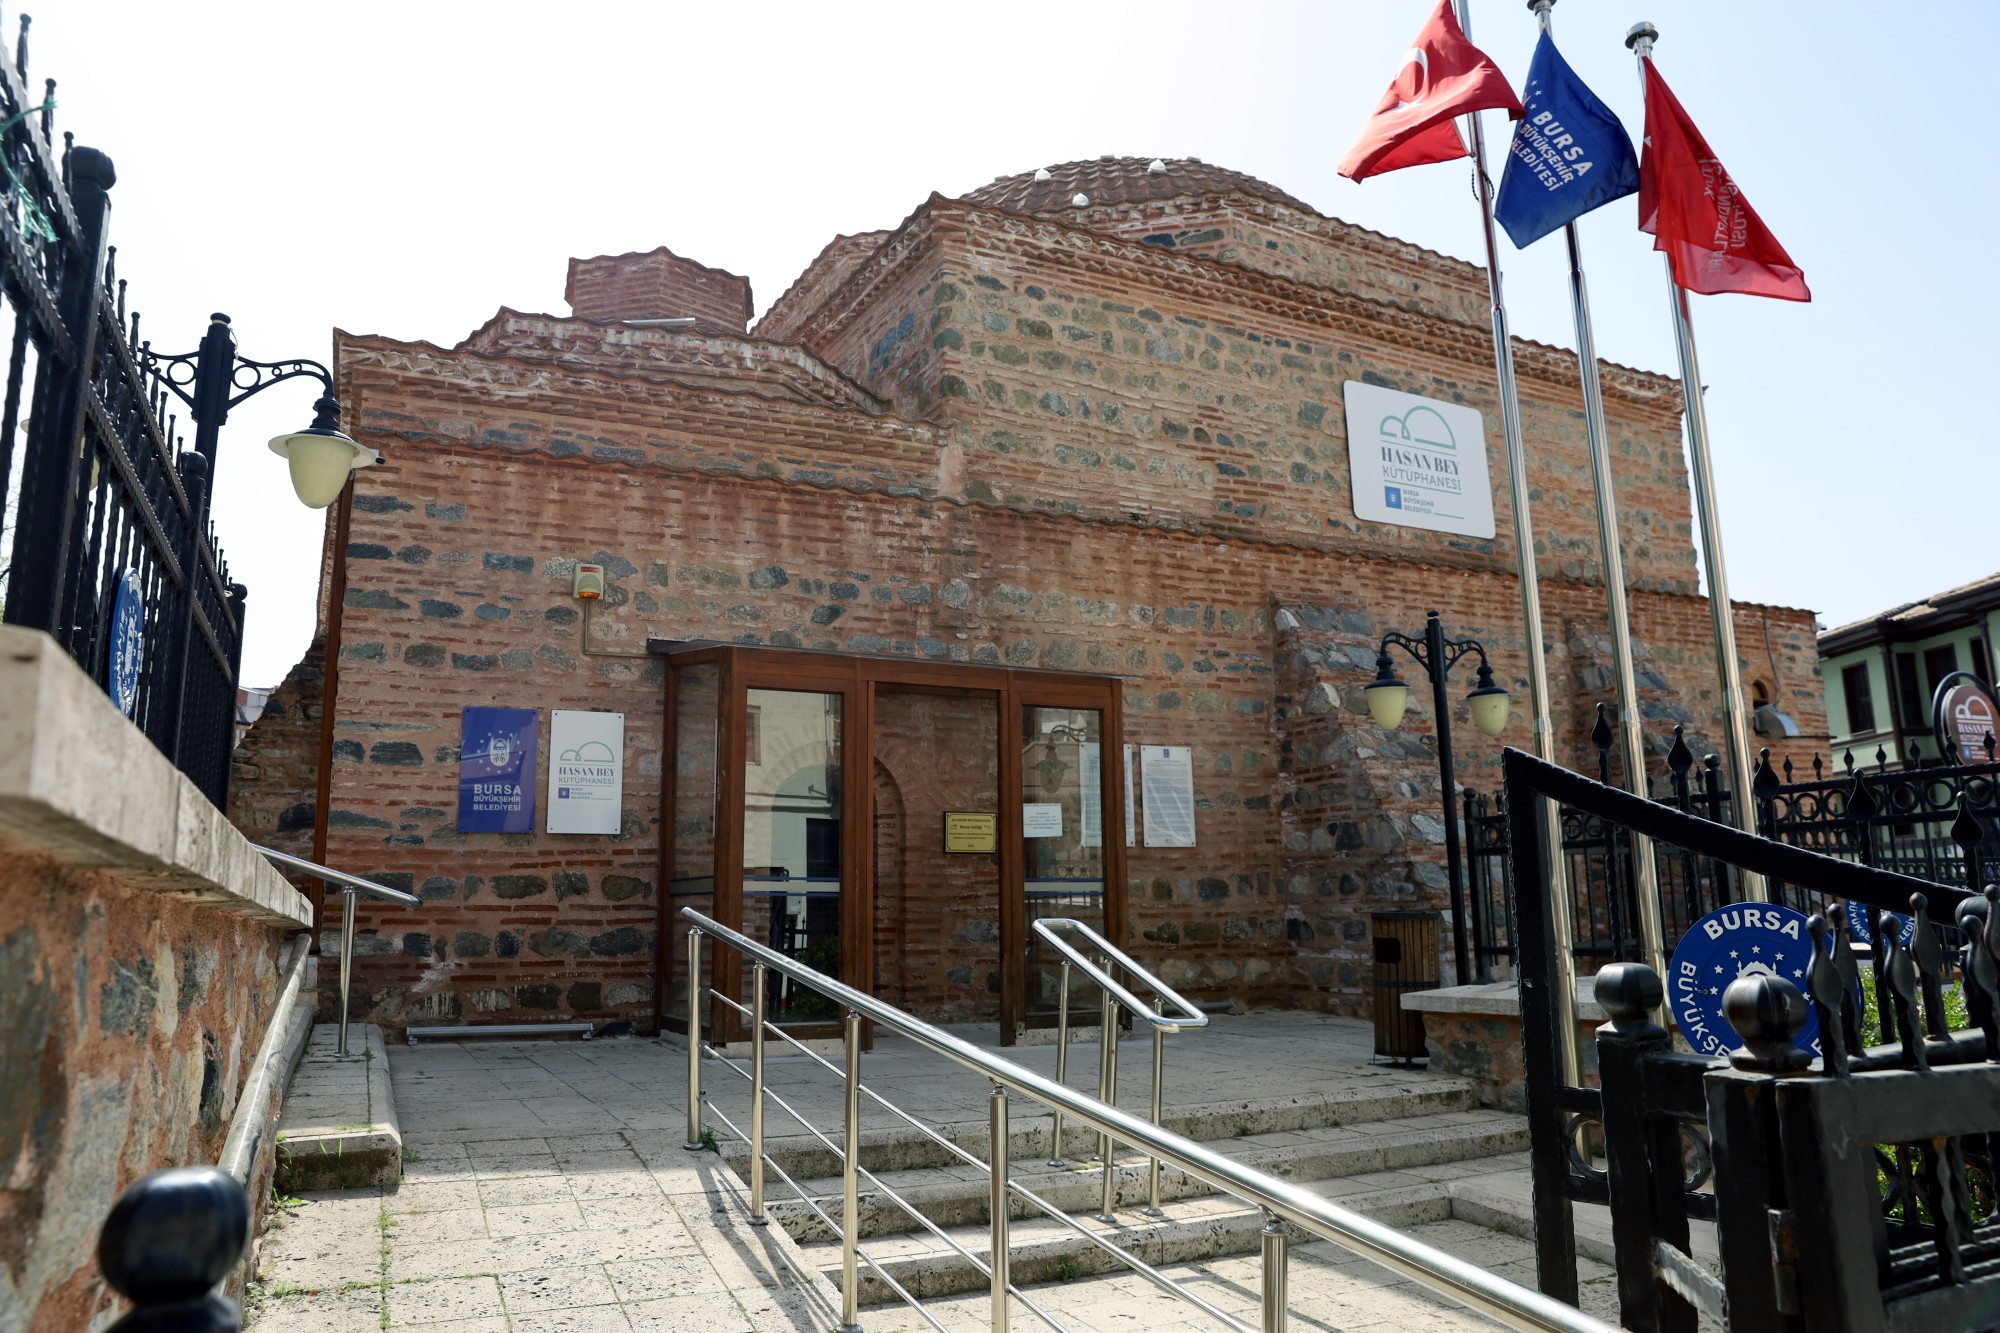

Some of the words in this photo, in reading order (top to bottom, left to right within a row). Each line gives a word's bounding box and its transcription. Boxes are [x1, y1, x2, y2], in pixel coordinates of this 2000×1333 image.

[1520, 123, 1575, 184] BÜYÜKŞEHİR
[1532, 111, 1593, 177] BURSA
[1381, 446, 1431, 470] HASAN
[1434, 457, 1460, 475] BEY
[1382, 465, 1462, 490] KÜTÜPHANESİ
[559, 766, 594, 776] HASAN
[596, 767, 615, 776] BEY
[473, 783, 521, 795] BURSA
[473, 794, 521, 802] BÜYÜKŞEHİR
[473, 802, 521, 811] BELEDİYESİ
[1702, 908, 1799, 941] BURSA
[1677, 961, 1731, 1058] BÜYÜKŞE
